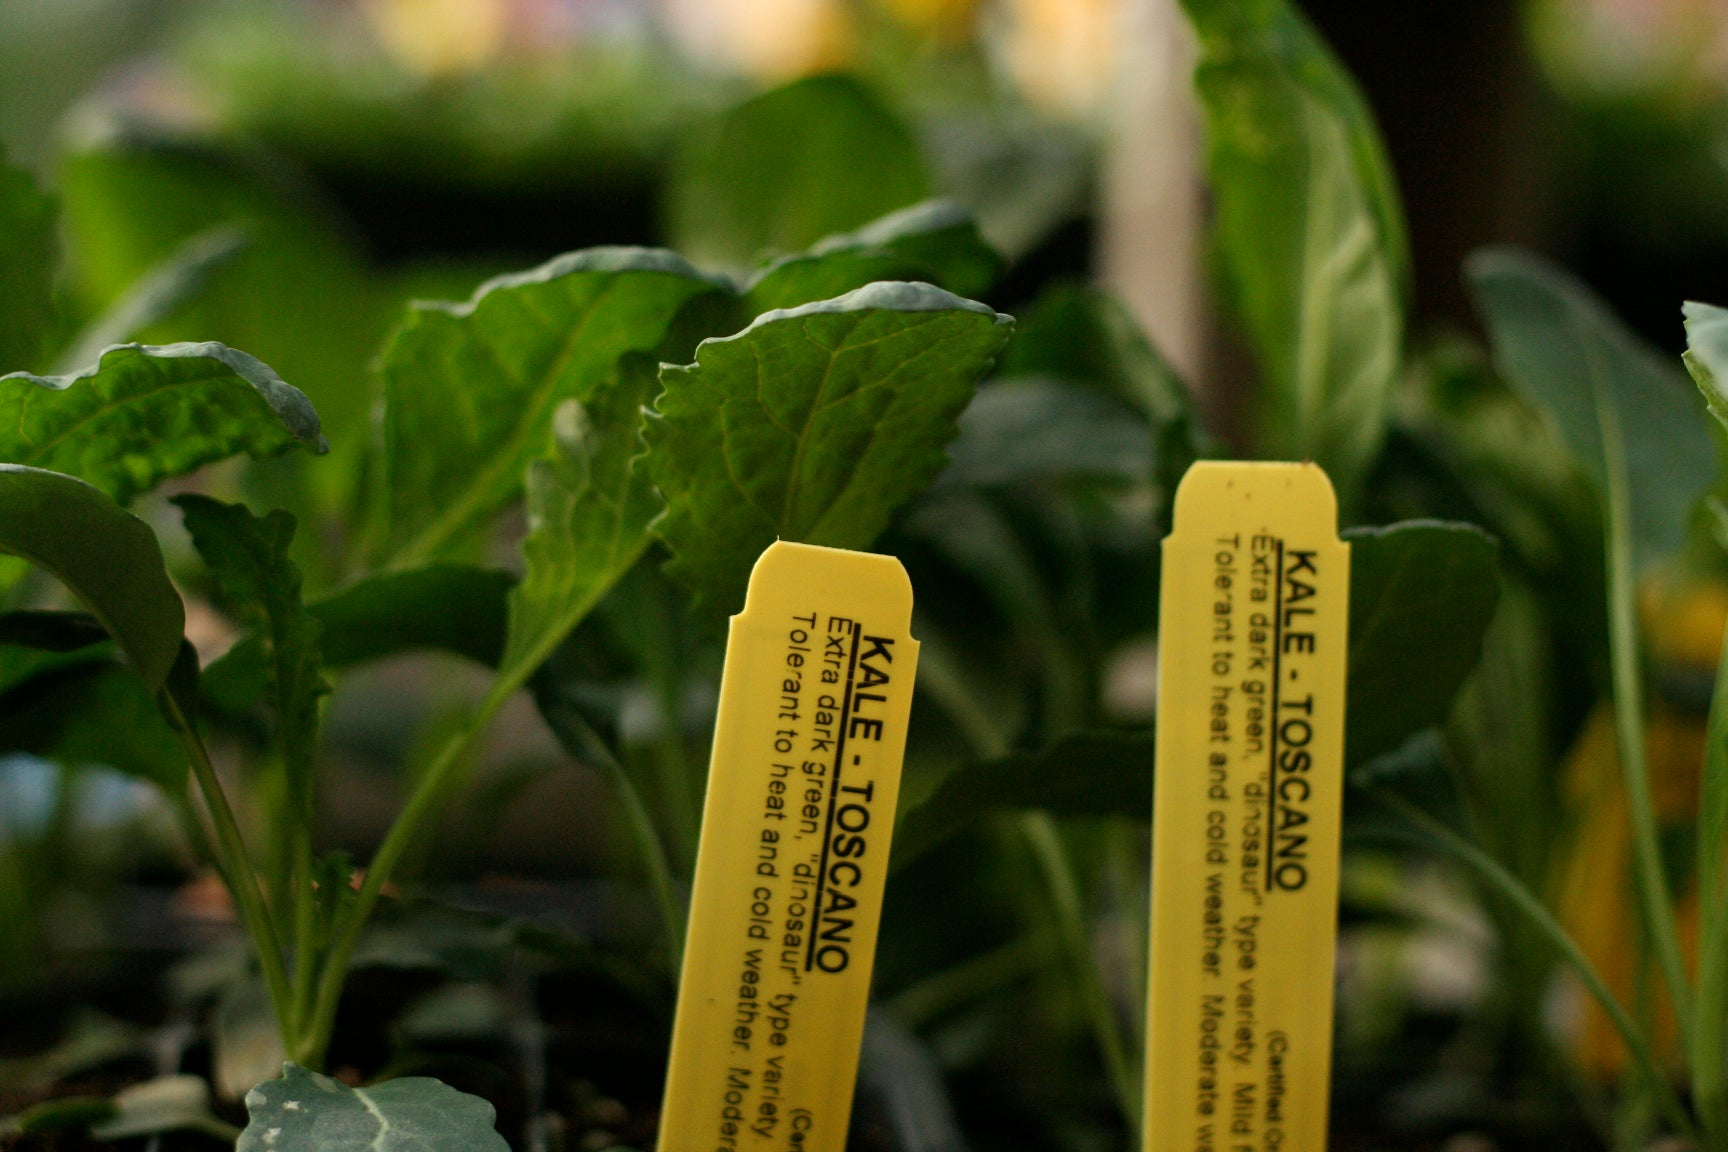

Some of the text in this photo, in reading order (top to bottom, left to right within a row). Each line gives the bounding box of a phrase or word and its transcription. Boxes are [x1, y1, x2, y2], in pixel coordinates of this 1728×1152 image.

[1213, 533, 1240, 642] Tolerant
[1250, 534, 1275, 602] Extra
[1284, 550, 1318, 654] KALE
[779, 612, 817, 721] Tolerant
[820, 616, 853, 684] Extra
[1212, 651, 1234, 676] to
[1249, 612, 1271, 670] dark
[849, 635, 895, 741] KALE
[1210, 685, 1234, 743] heat
[1241, 680, 1265, 760] green,
[774, 729, 799, 753] to
[811, 694, 840, 752] dark
[764, 763, 795, 820] heat
[794, 760, 826, 840] green,
[1208, 751, 1230, 801] and
[1275, 692, 1313, 892] TOSCANO
[756, 829, 780, 878] and
[1206, 810, 1229, 864] cold
[1240, 772, 1268, 906] "dinosaur"
[816, 780, 874, 974] TOSCANO
[748, 886, 773, 940] cold
[780, 854, 820, 985] "dinosaur"
[1232, 916, 1261, 970] type
[730, 948, 763, 1054] weather.
[768, 992, 798, 1046] type
[1196, 994, 1224, 1115] Moderate
[1231, 1082, 1257, 1135] Mild
